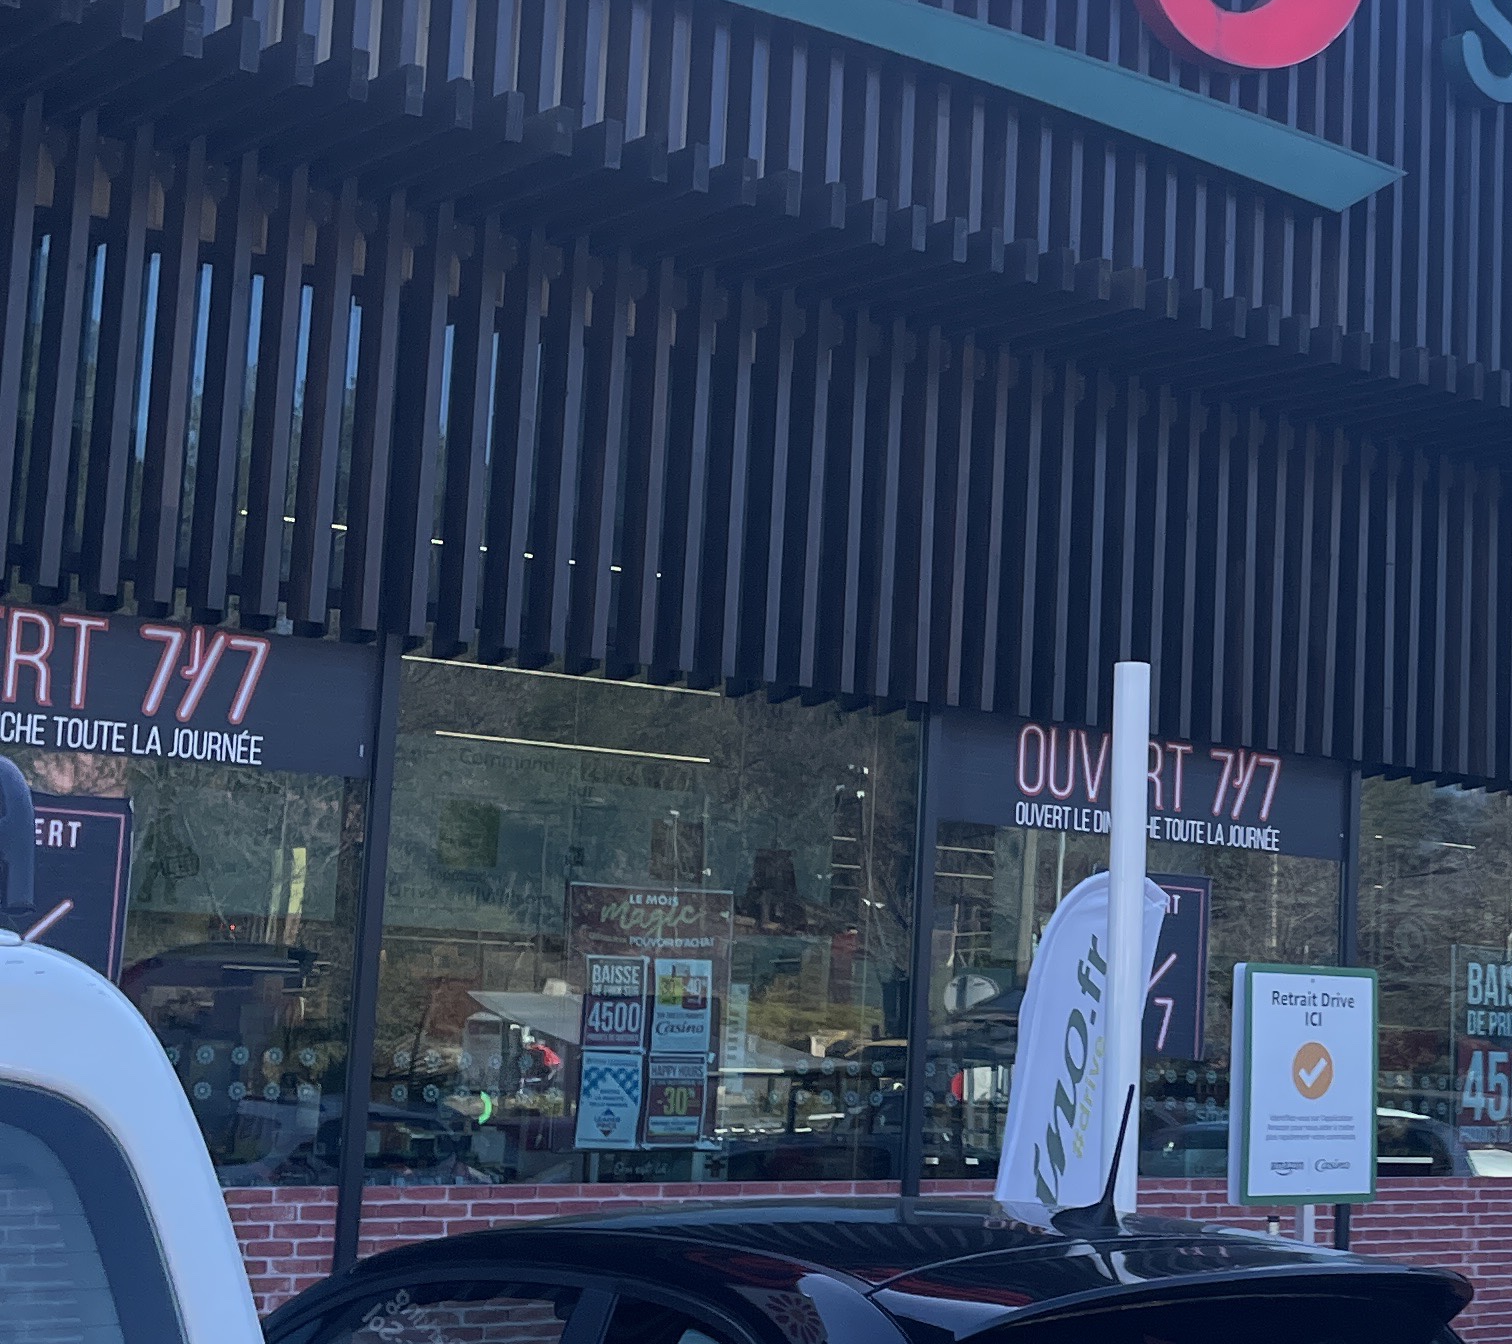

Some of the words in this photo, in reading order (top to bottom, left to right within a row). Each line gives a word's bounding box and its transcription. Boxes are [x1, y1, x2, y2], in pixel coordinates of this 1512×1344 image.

[0, 606, 109, 709] RT
[0, 711, 47, 745] CHE
[53, 716, 127, 753] TOUTE
[132, 724, 162, 755] LA
[167, 727, 263, 765] JOURNÉE
[1017, 722, 1193, 812] OUVRT
[1015, 801, 1071, 829] OUVERT
[1074, 809, 1090, 832] LE
[1164, 817, 1204, 844] TOUTE
[1207, 822, 1225, 846] LA
[1226, 824, 1281, 852] JOURNÉE
[629, 894, 642, 905] LE
[645, 895, 679, 906] MOIS
[592, 964, 640, 985] BAISSE
[1272, 991, 1317, 1007] Retrait
[1321, 992, 1355, 1009] Drive
[588, 1001, 640, 1032] 4500
[655, 1021, 704, 1036] Casino
[1305, 1012, 1323, 1027] ICI
[1467, 1010, 1486, 1036] DE
